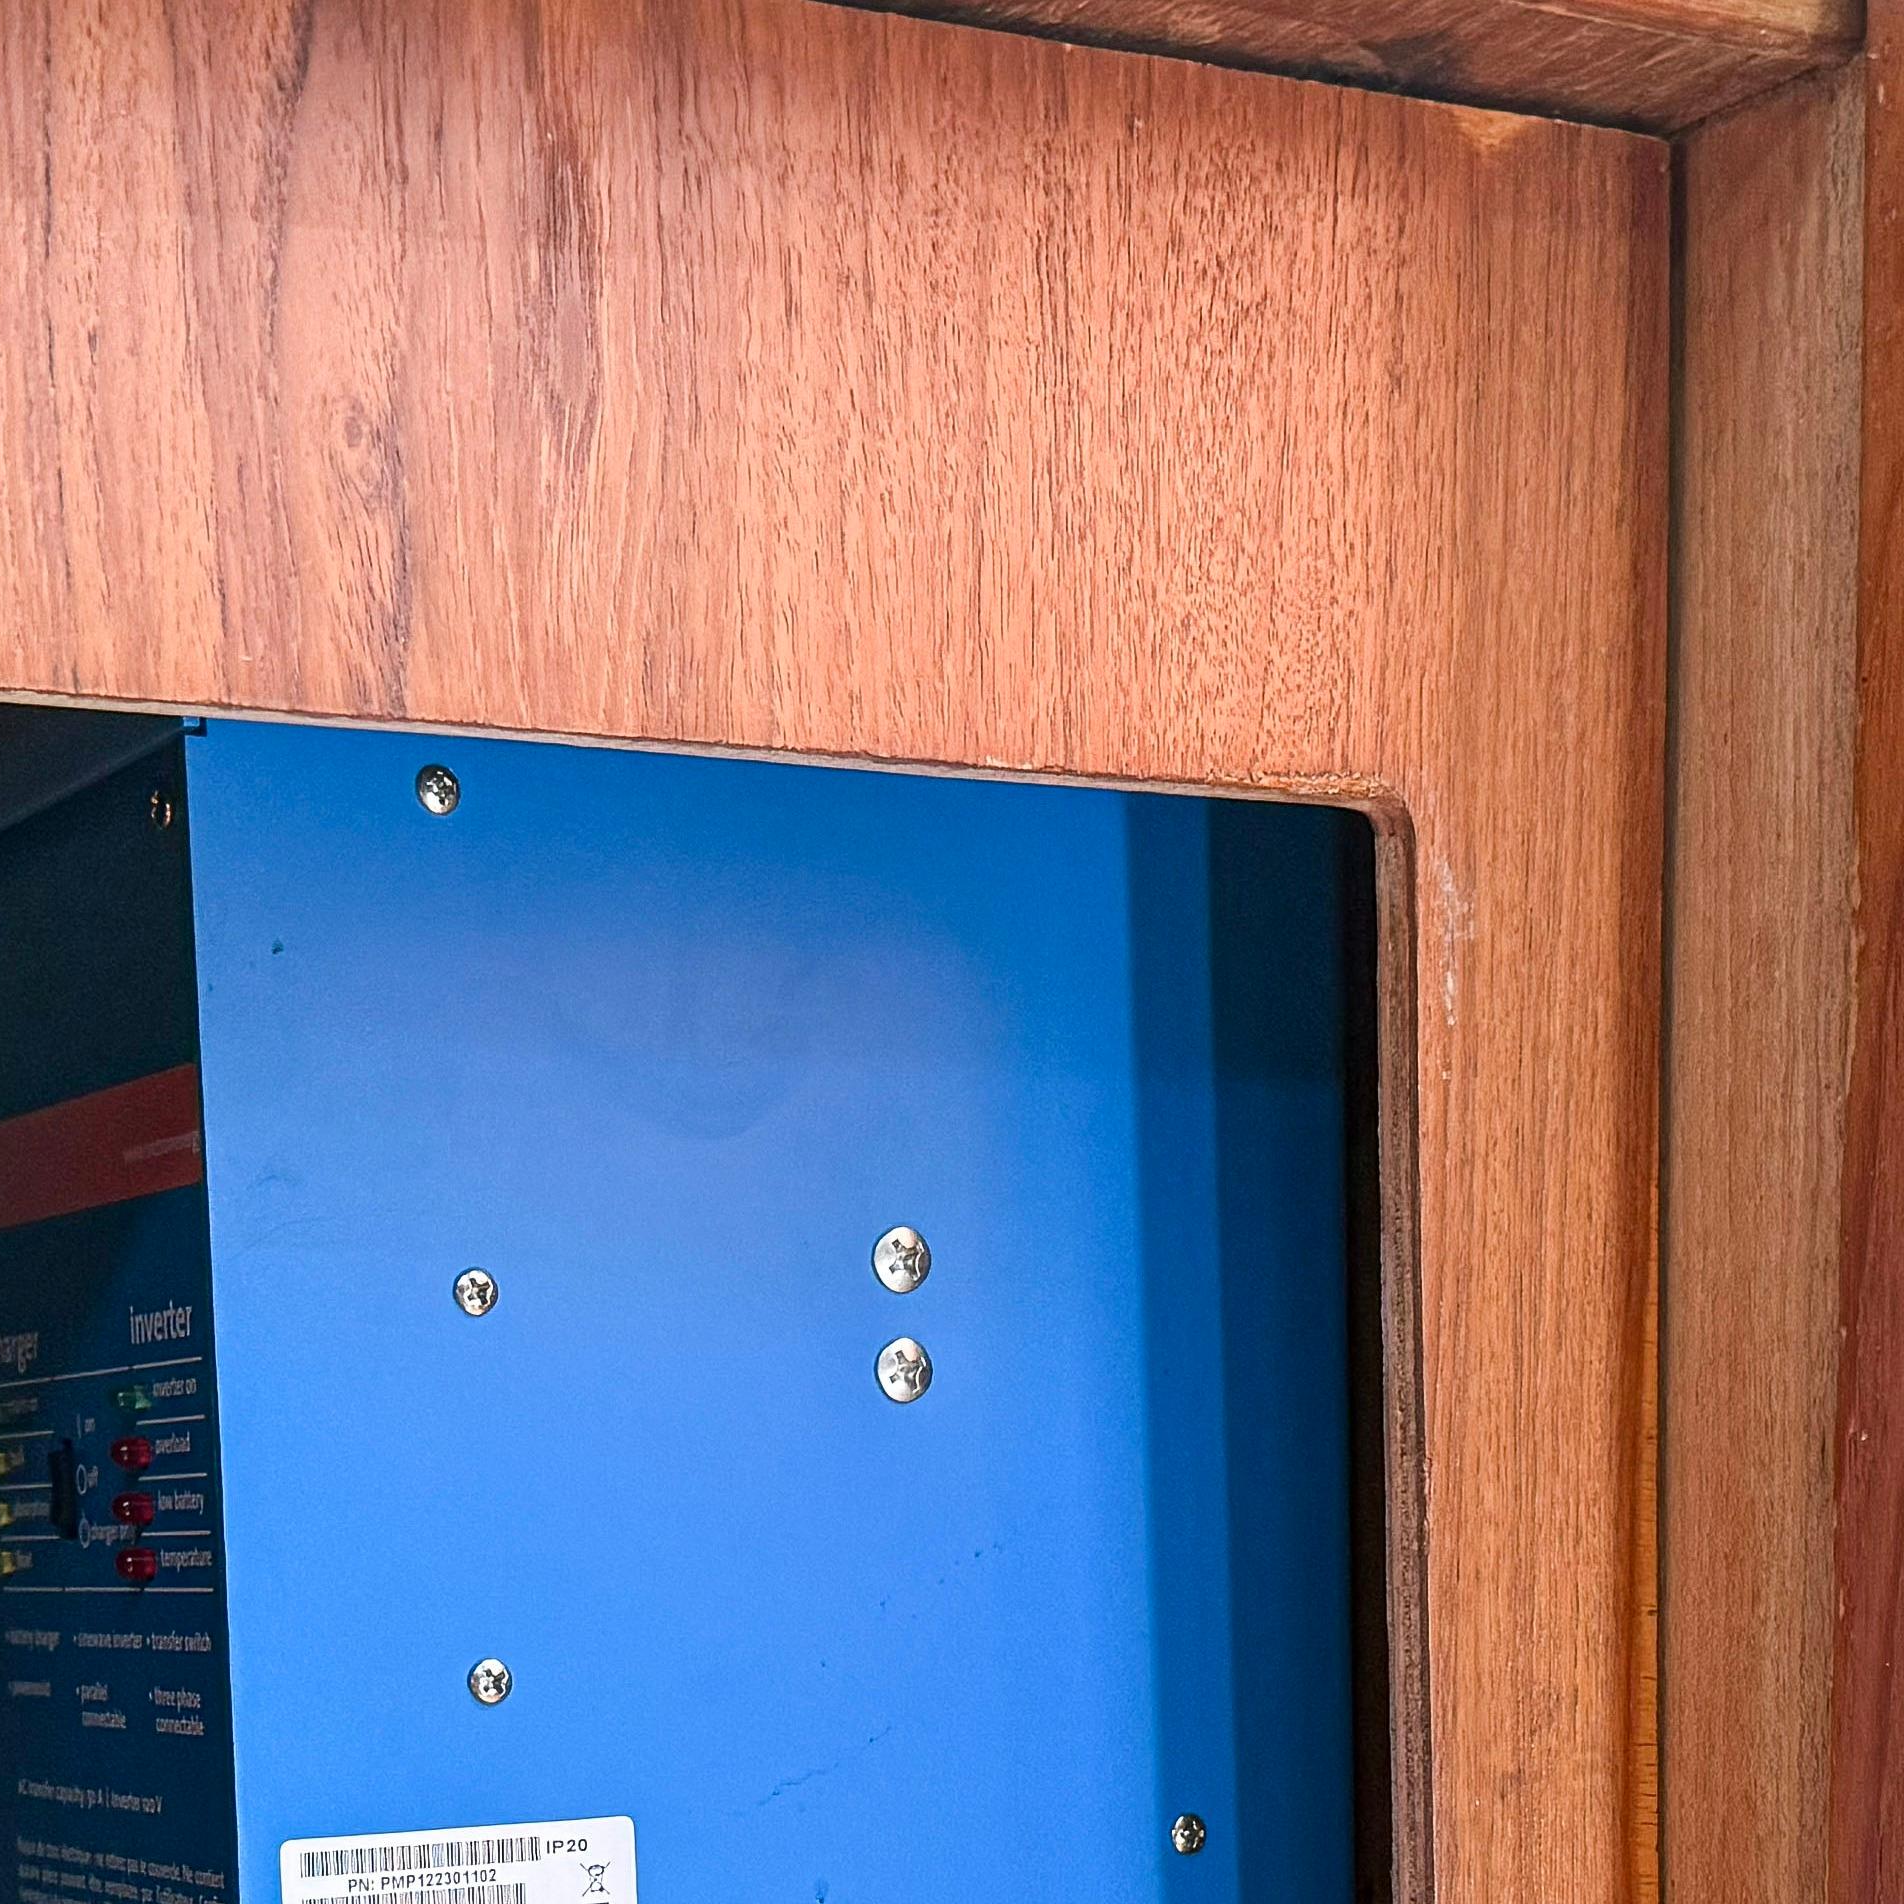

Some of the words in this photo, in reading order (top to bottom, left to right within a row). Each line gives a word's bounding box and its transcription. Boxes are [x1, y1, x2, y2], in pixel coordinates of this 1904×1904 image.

[129, 1299, 193, 1345] inverter
[174, 1490, 205, 1515] battery
[160, 1547, 213, 1573] temperature
[547, 1839, 588, 1854] IP20
[348, 1878, 375, 1893] PN:
[381, 1868, 497, 1890] PMP122301102
